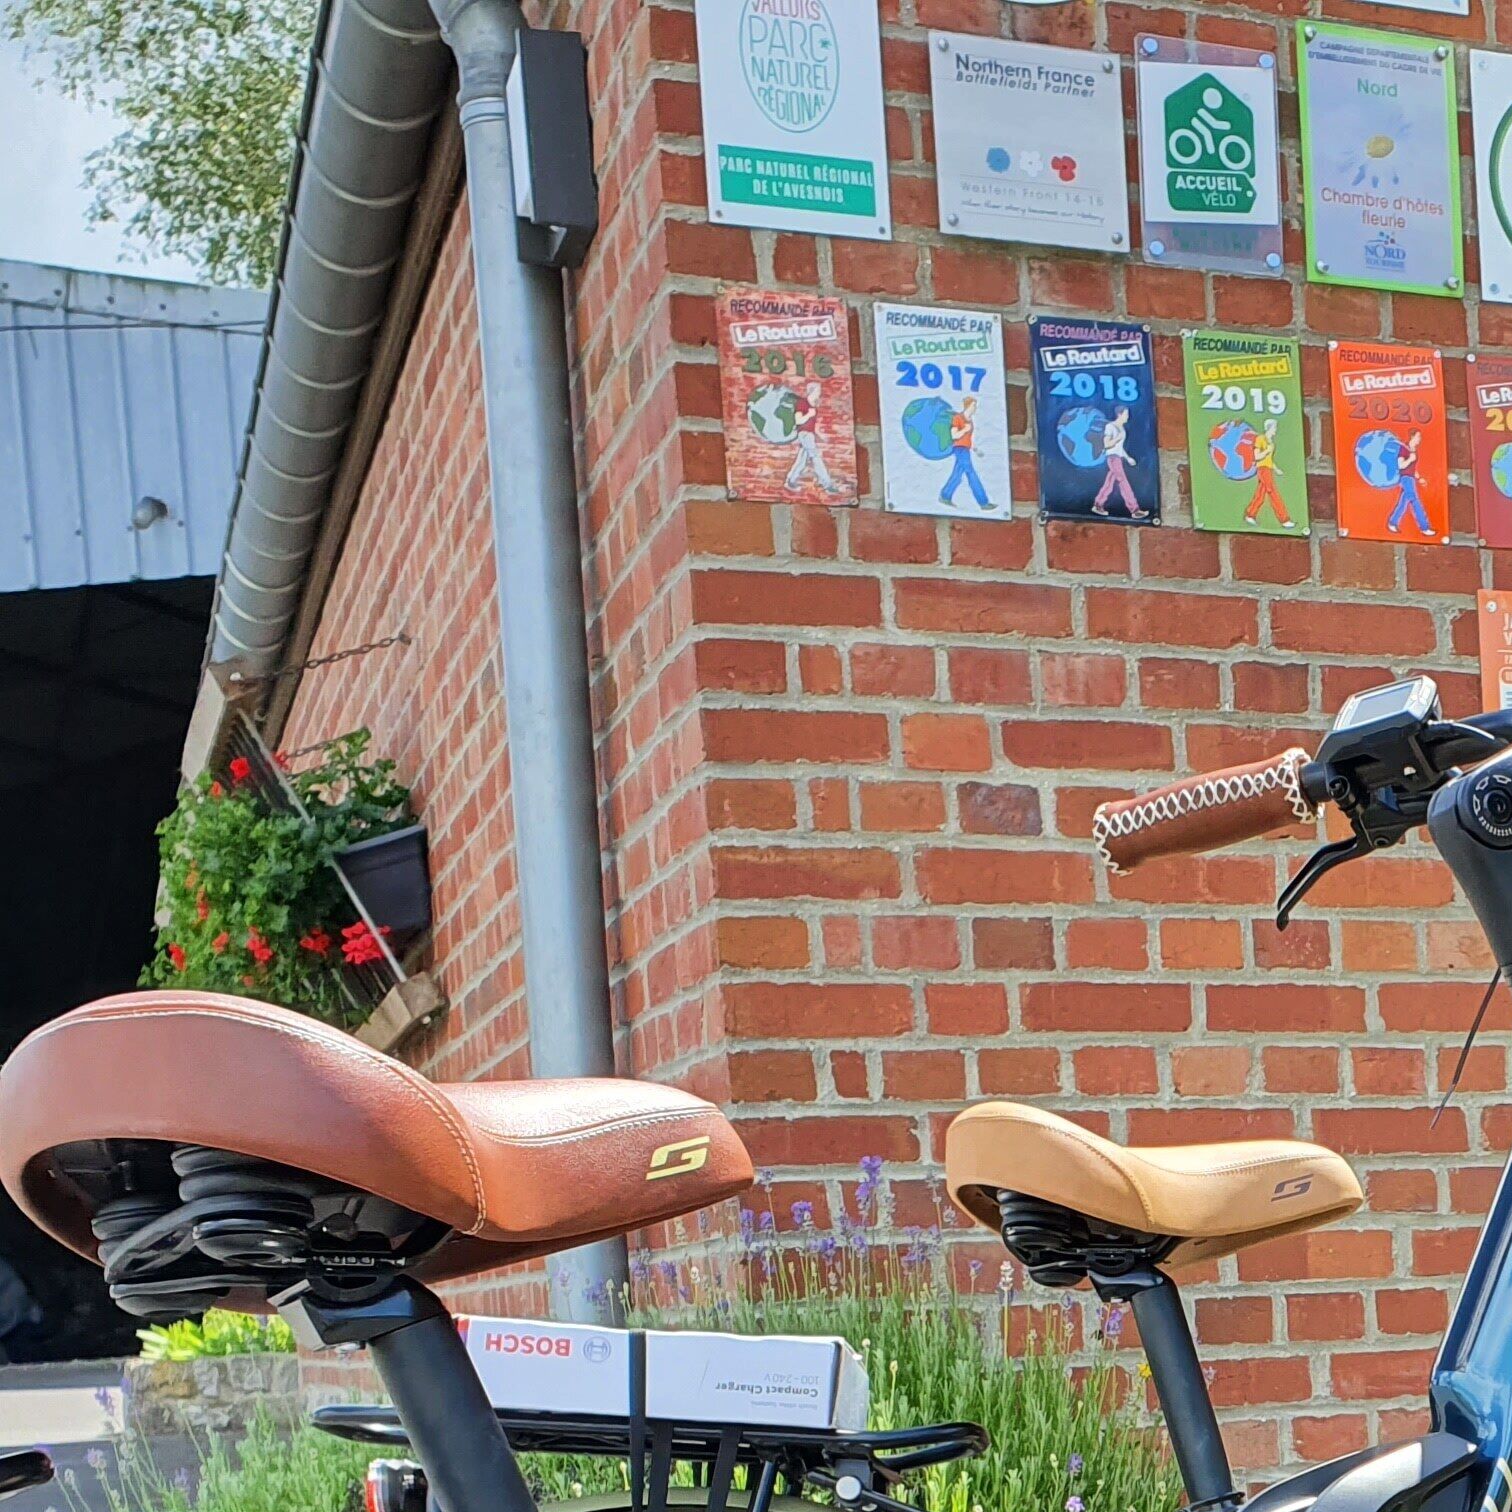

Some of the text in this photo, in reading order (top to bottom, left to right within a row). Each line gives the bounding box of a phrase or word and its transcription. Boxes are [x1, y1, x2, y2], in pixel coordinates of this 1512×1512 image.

[748, 14, 829, 63] PARC
[751, 56, 832, 91] NATUREL
[955, 53, 1095, 87] Northern France
[956, 71, 1095, 98] Battlefields Partner
[1357, 78, 1398, 97] Nord
[757, 85, 826, 124] RÉGIONAL
[720, 156, 873, 187] PARC NATUREL RÉGIONAL
[1175, 175, 1242, 192] ACCUEIL
[753, 179, 844, 204] DE L'AVESNOIS
[960, 181, 1016, 197] Western
[1022, 188, 1059, 201] Front
[1202, 190, 1237, 206] VÉLO
[1321, 187, 1444, 216] Chambre d'hôtes
[1362, 209, 1406, 228] fleurie
[1364, 244, 1407, 260] NORD
[730, 299, 810, 319] RECOMMANDÉ
[735, 319, 832, 344] Le Routard
[886, 311, 993, 334] RECOMMANDÉ PAR
[1039, 324, 1118, 341] RECOMMANDÉ
[891, 331, 989, 357] Le Routard
[1045, 343, 1141, 367] Le Routard
[1193, 338, 1269, 355] RECOMMANDÉ
[741, 349, 835, 378] 2016
[1198, 357, 1290, 380] Le Routard
[1339, 349, 1412, 366] RECOMMANDÉ
[896, 361, 987, 393] 2017
[1049, 372, 1139, 401] 2018
[1343, 367, 1432, 392] Le Routard
[1200, 385, 1287, 415] 2019
[1481, 389, 1500, 404] Le
[1348, 397, 1433, 425] 2020
[485, 1332, 571, 1357] BOSCH
[715, 1382, 819, 1398] Compact Charger
